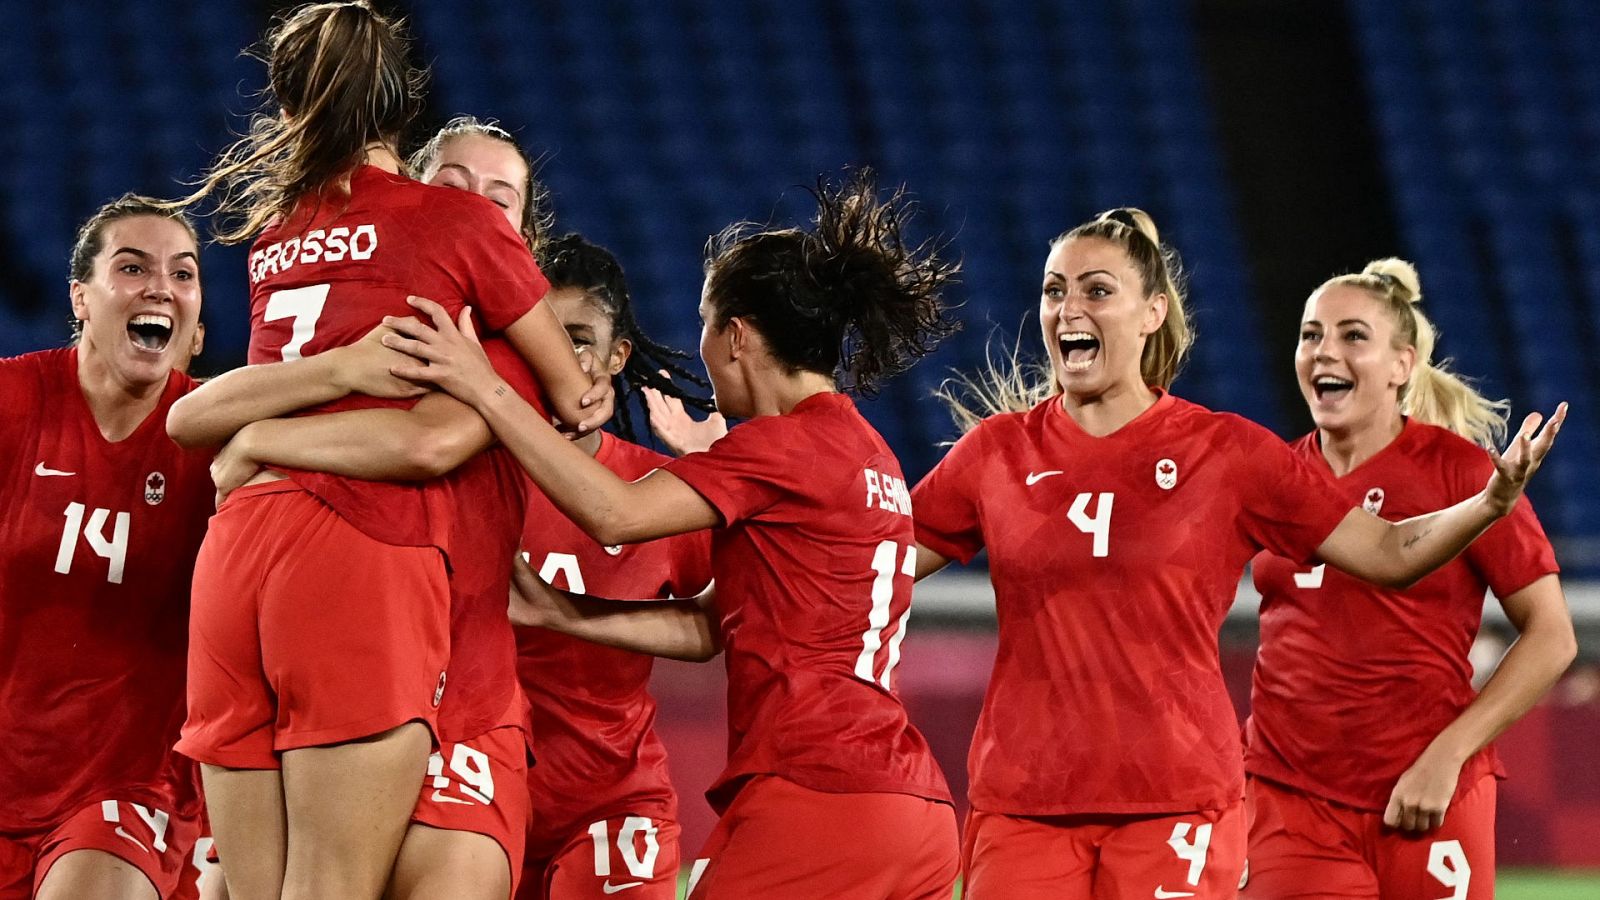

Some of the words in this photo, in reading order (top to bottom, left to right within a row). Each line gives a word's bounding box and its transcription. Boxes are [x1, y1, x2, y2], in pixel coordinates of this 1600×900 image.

[249, 224, 378, 284] GROSSO
[263, 283, 331, 362] 7
[54, 501, 131, 584] 14
[1066, 492, 1115, 557] 4
[427, 743, 494, 806] 19
[587, 816, 660, 879] 10
[1166, 821, 1213, 887] 4
[1426, 839, 1472, 900] 9
